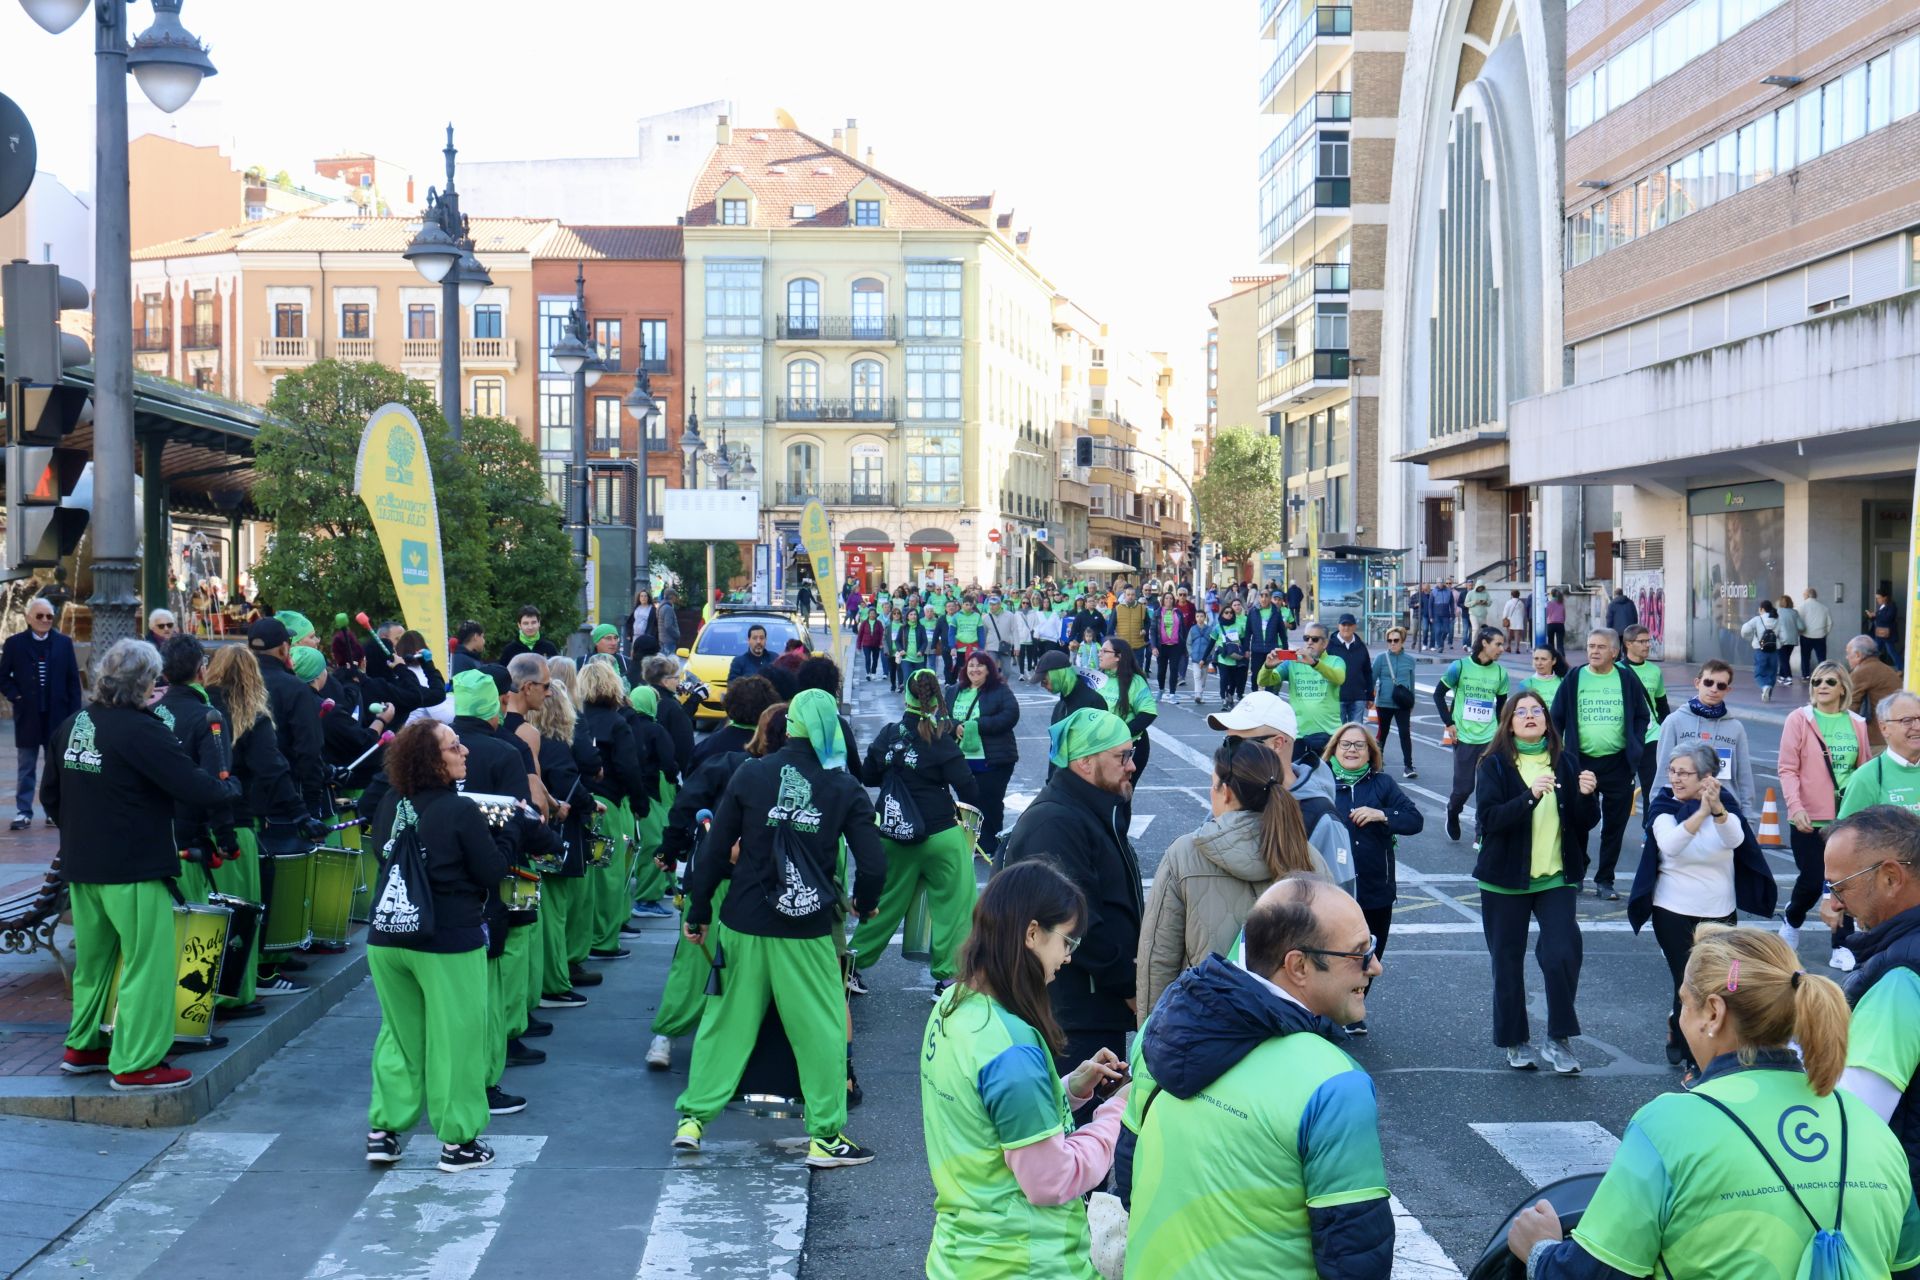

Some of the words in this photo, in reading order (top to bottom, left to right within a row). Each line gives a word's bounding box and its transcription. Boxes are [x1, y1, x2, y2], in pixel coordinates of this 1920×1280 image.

[1467, 707, 1490, 715] 11501
[1582, 706, 1611, 714] contra
[1582, 714, 1592, 722] el
[1710, 734, 1737, 745] ONES
[1828, 744, 1858, 752] march
[1889, 793, 1905, 802] En
[1215, 1101, 1223, 1109] EL
[1223, 1103, 1248, 1121] CÁNCER
[1720, 1192, 1734, 1200] XIV
[1736, 1185, 1785, 1198] VALLADOLID
[1796, 1181, 1827, 1190] MARCHA
[1828, 1181, 1858, 1189] COTRA
[1860, 1180, 1868, 1188] EL
